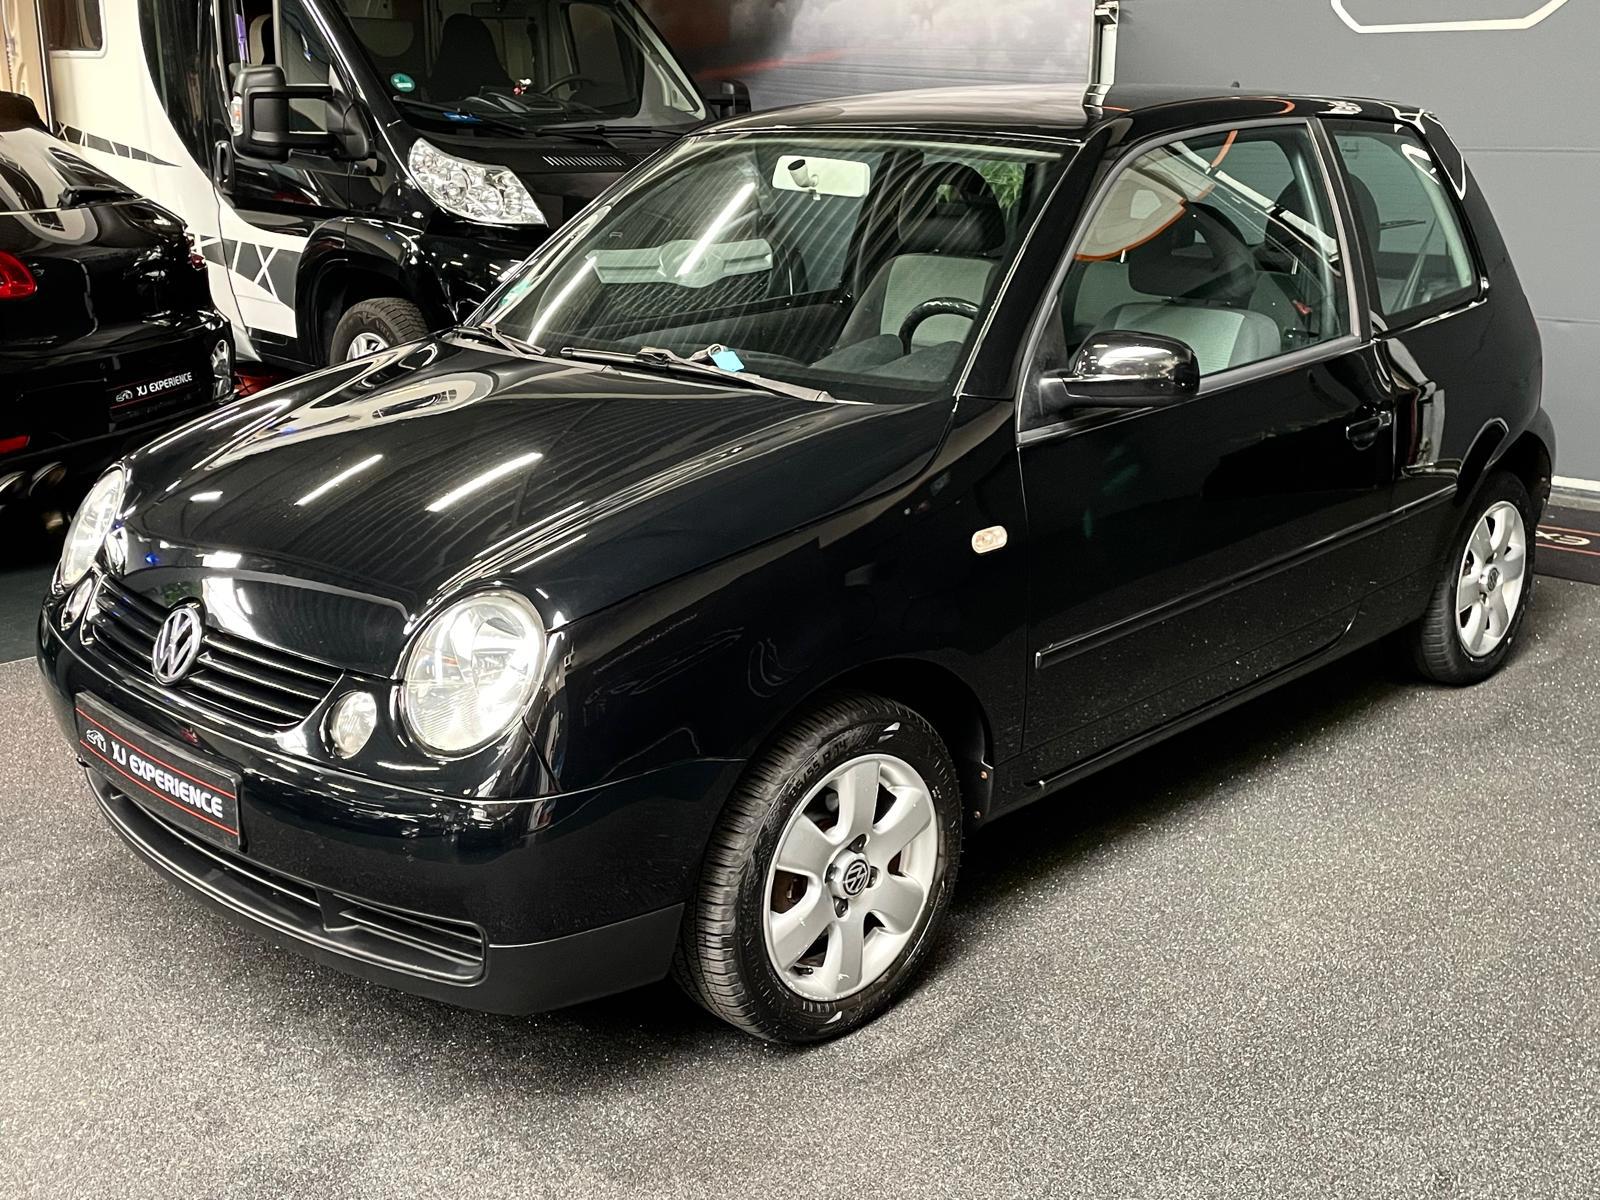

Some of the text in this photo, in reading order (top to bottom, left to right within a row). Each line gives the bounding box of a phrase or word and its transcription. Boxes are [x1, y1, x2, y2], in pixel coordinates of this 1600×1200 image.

[136, 371, 193, 396] XJ EXPERIENCE
[111, 741, 224, 819] XJ EXPERIENCE
